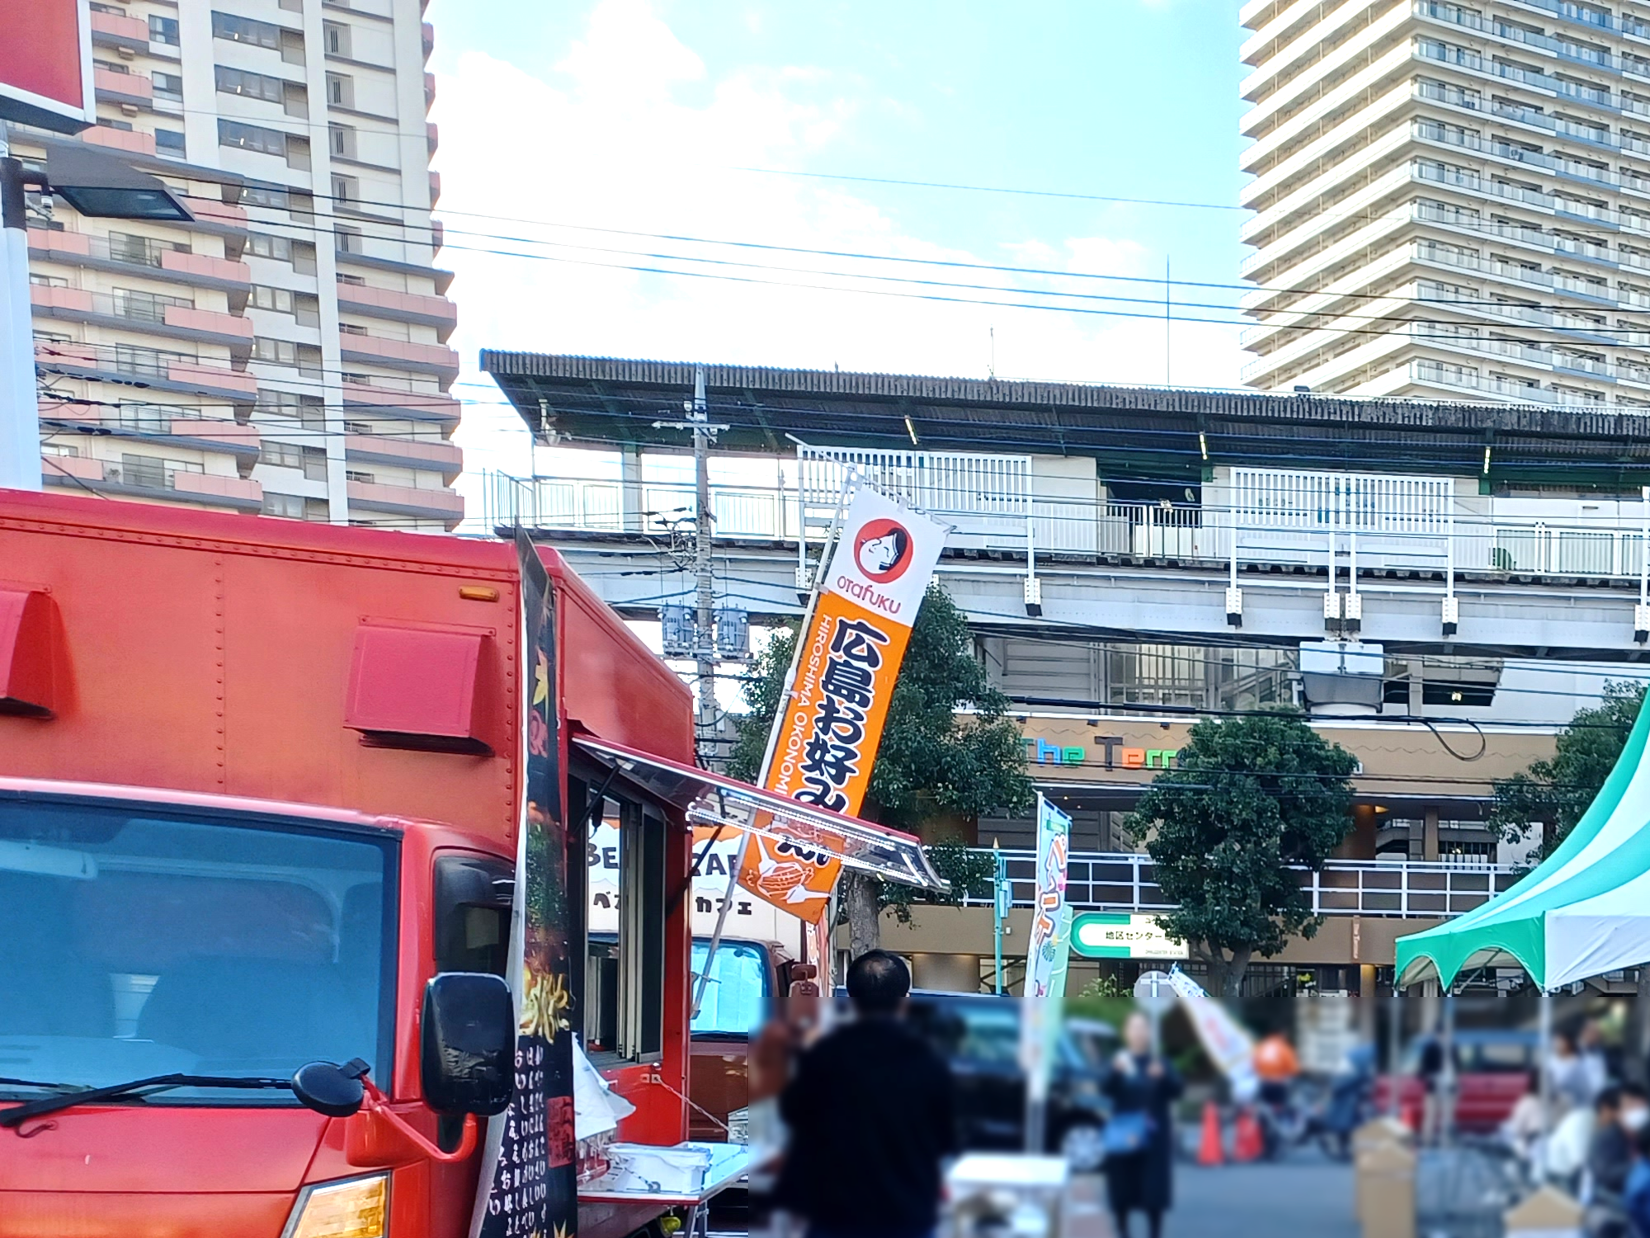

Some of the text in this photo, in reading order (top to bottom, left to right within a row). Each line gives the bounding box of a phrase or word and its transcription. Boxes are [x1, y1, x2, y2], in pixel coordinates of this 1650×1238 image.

[774, 613, 833, 801] HIROSHIMA OKONOMI
[1021, 736, 1178, 772] The Terr
[1105, 930, 1176, 943] 地区センター
